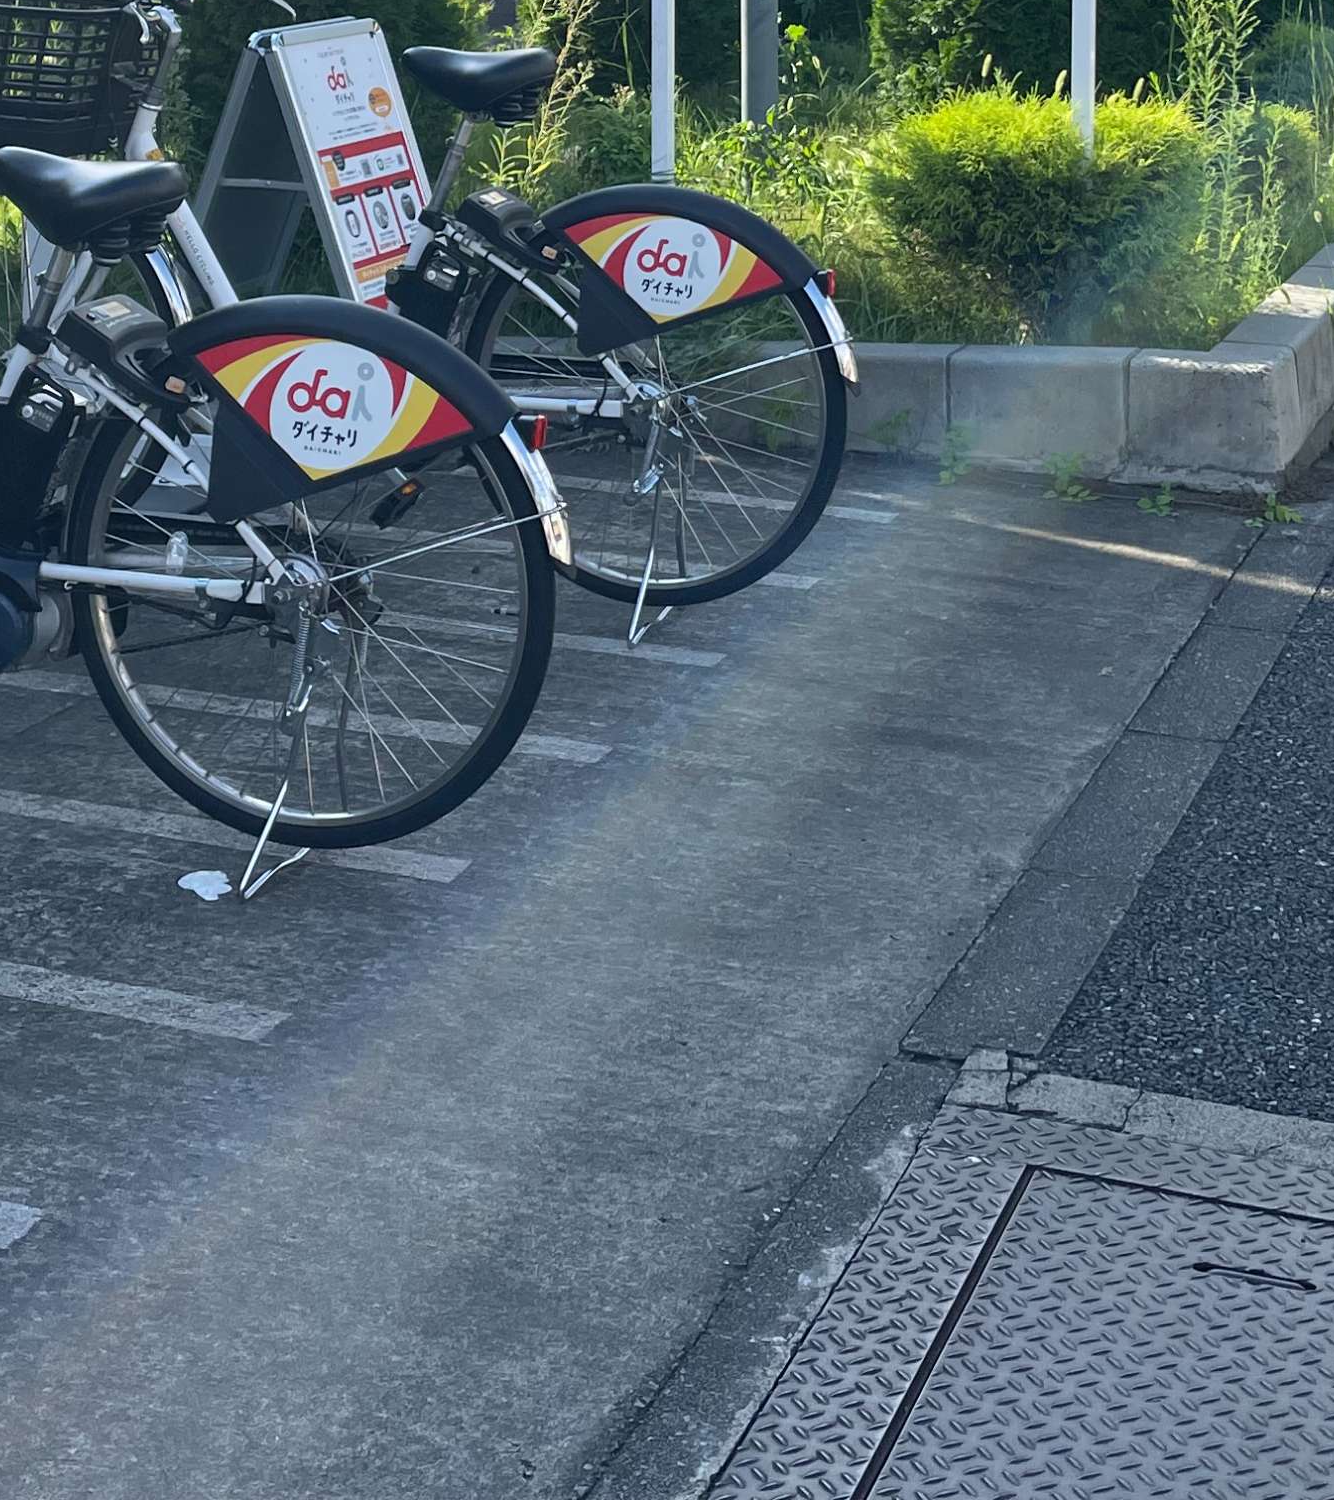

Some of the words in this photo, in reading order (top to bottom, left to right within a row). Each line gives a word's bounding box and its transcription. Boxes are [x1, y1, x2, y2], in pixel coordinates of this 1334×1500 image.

[636, 232, 706, 279] dai
[641, 278, 694, 300] ダイチャリ
[286, 362, 375, 422] dai
[291, 420, 358, 449] ダイチャリ
